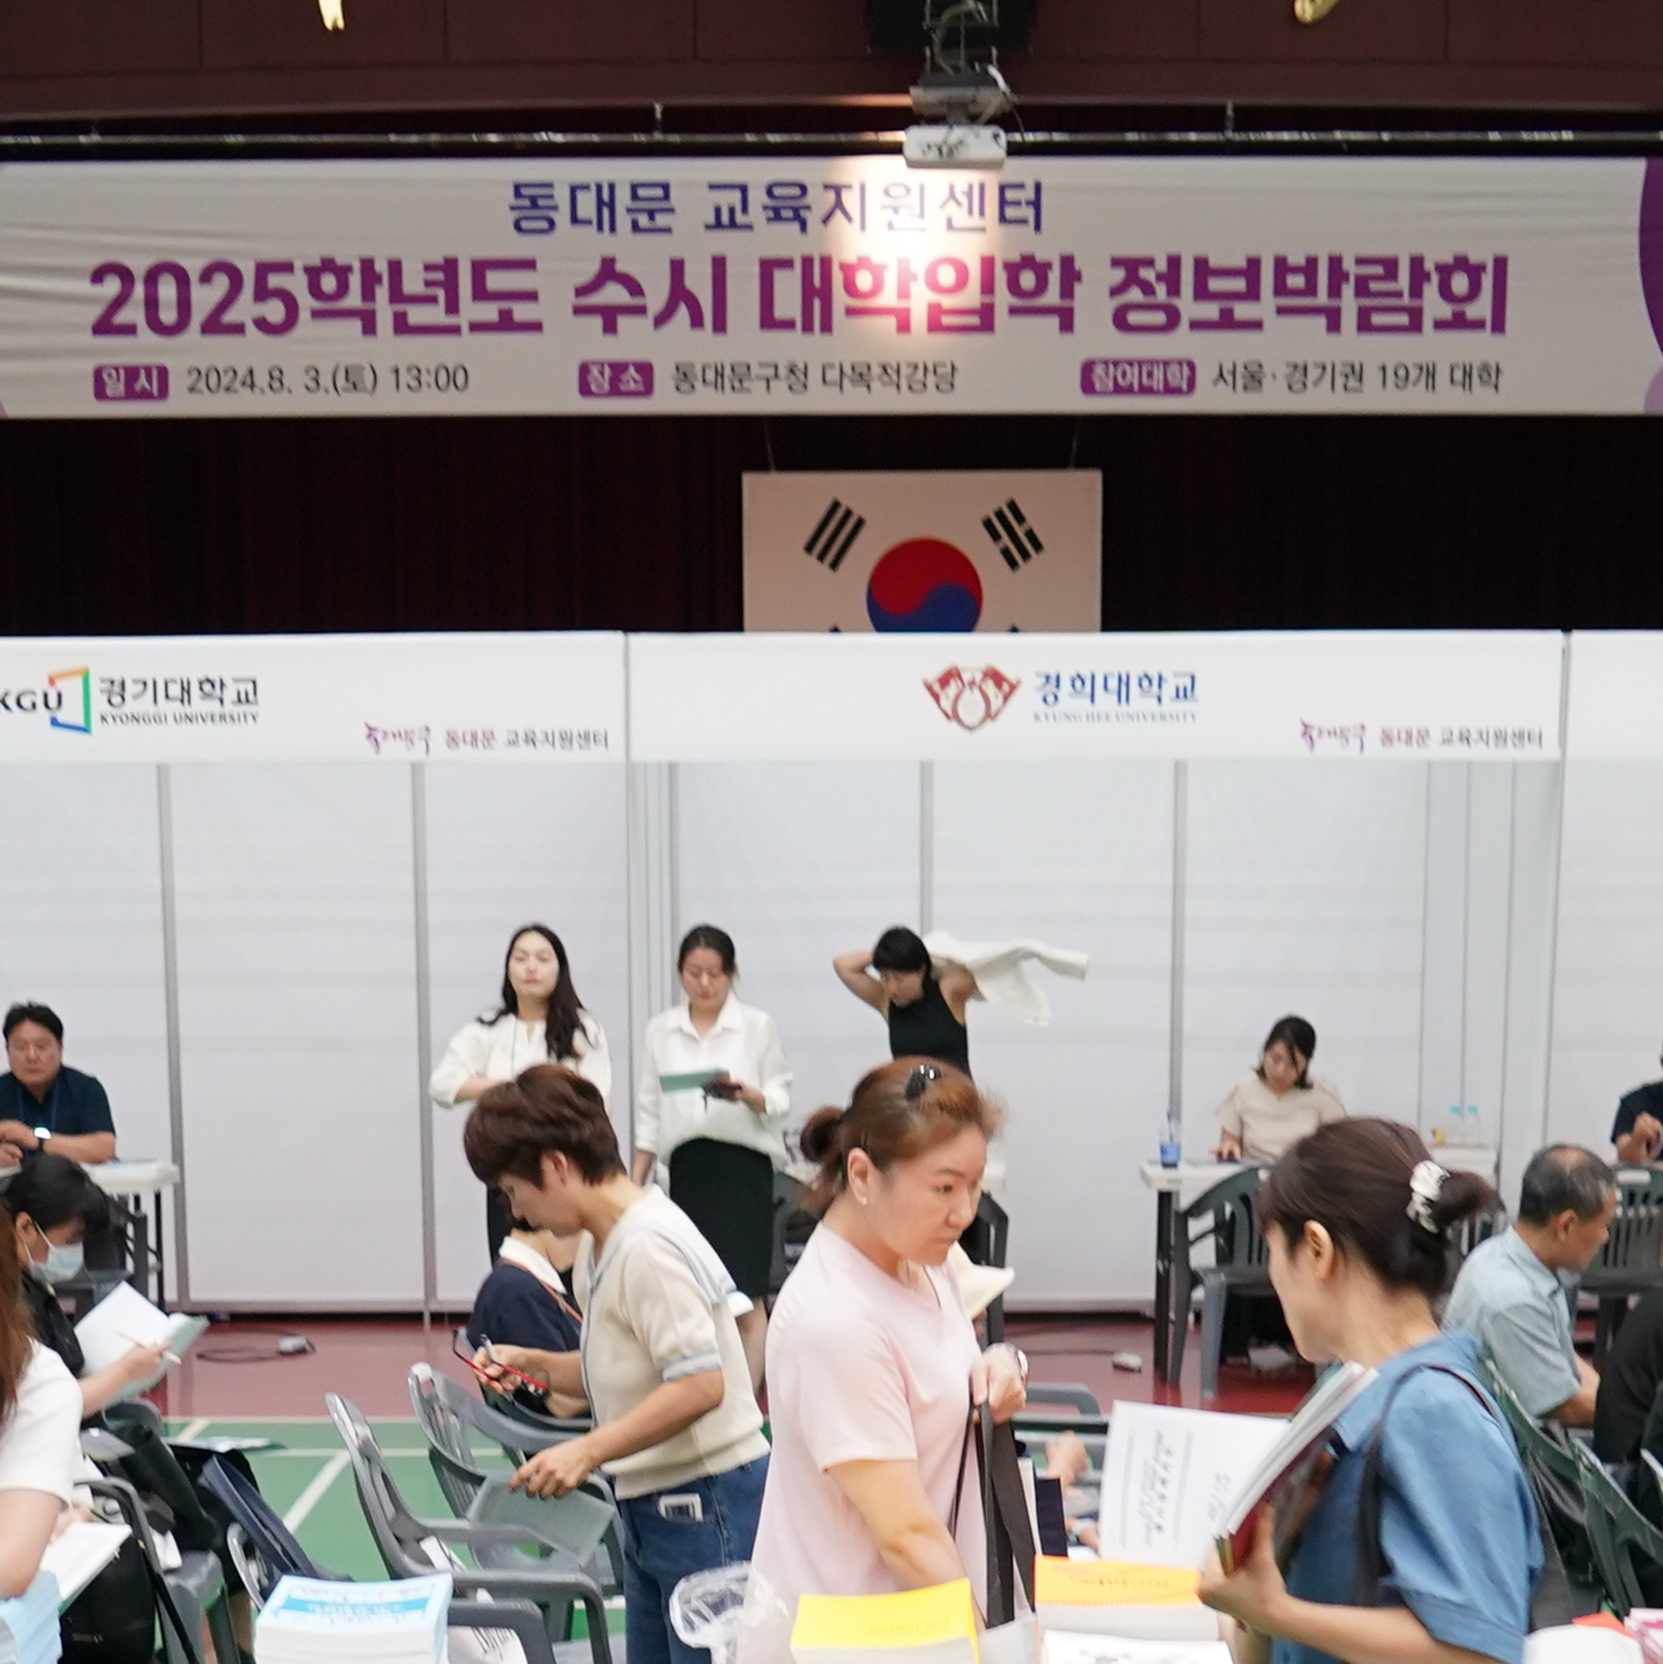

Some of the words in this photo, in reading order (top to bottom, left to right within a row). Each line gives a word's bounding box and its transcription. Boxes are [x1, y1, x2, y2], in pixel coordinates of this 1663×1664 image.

[508, 181, 676, 236] 동대문
[703, 180, 1043, 236] 교육지원센터
[89, 255, 544, 338] 2025학년도
[571, 254, 728, 336] 수시
[758, 254, 1083, 335] 대학입학
[1108, 253, 1509, 335] 정보박람회
[102, 367, 159, 397] 일시
[392, 364, 470, 393] 13:00
[585, 363, 641, 395] 장소
[673, 361, 809, 394] 동대문구청
[821, 361, 958, 394] 다목적강당
[1092, 361, 1190, 394] 참여대학
[1212, 361, 1364, 394] 서울·경기권
[1379, 361, 1437, 393] 19개
[1449, 361, 1502, 394] 대학
[98, 676, 259, 709] 경기대학교
[1034, 670, 1198, 706] 경희대학교
[99, 712, 168, 725] KYONGGI
[172, 711, 257, 725] UNIVERSITY
[1033, 709, 1082, 724] KYUNG
[1085, 711, 1111, 723] HEE
[1114, 710, 1197, 723] UNIVERSITY
